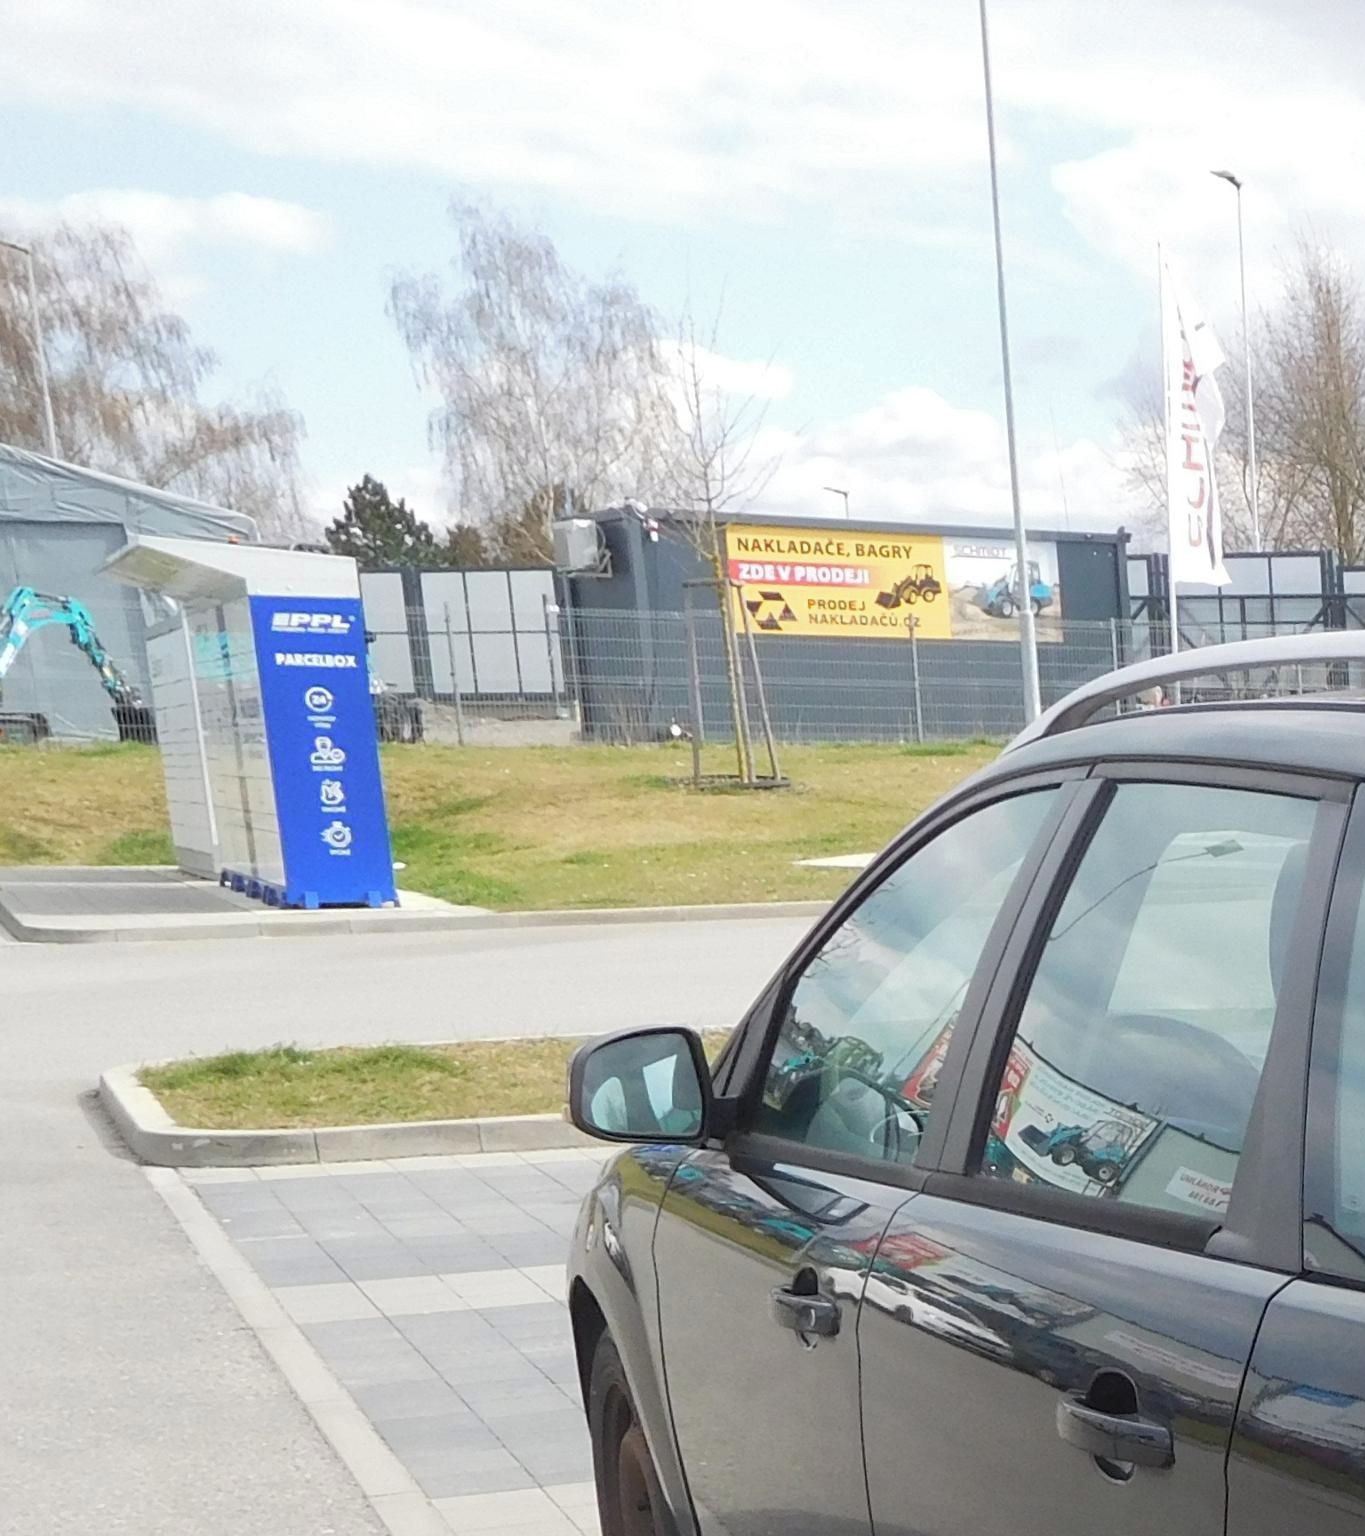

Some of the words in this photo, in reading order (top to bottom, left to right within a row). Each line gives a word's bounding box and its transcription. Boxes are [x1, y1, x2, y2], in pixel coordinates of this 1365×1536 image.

[737, 537, 850, 557] NAKLADAČE,
[855, 543, 912, 559] BAGRY
[738, 563, 776, 579] ZDE
[777, 565, 790, 580] V
[808, 599, 866, 611] PRODEJ
[289, 612, 350, 629] PPL
[275, 652, 357, 668] PARCELBOX
